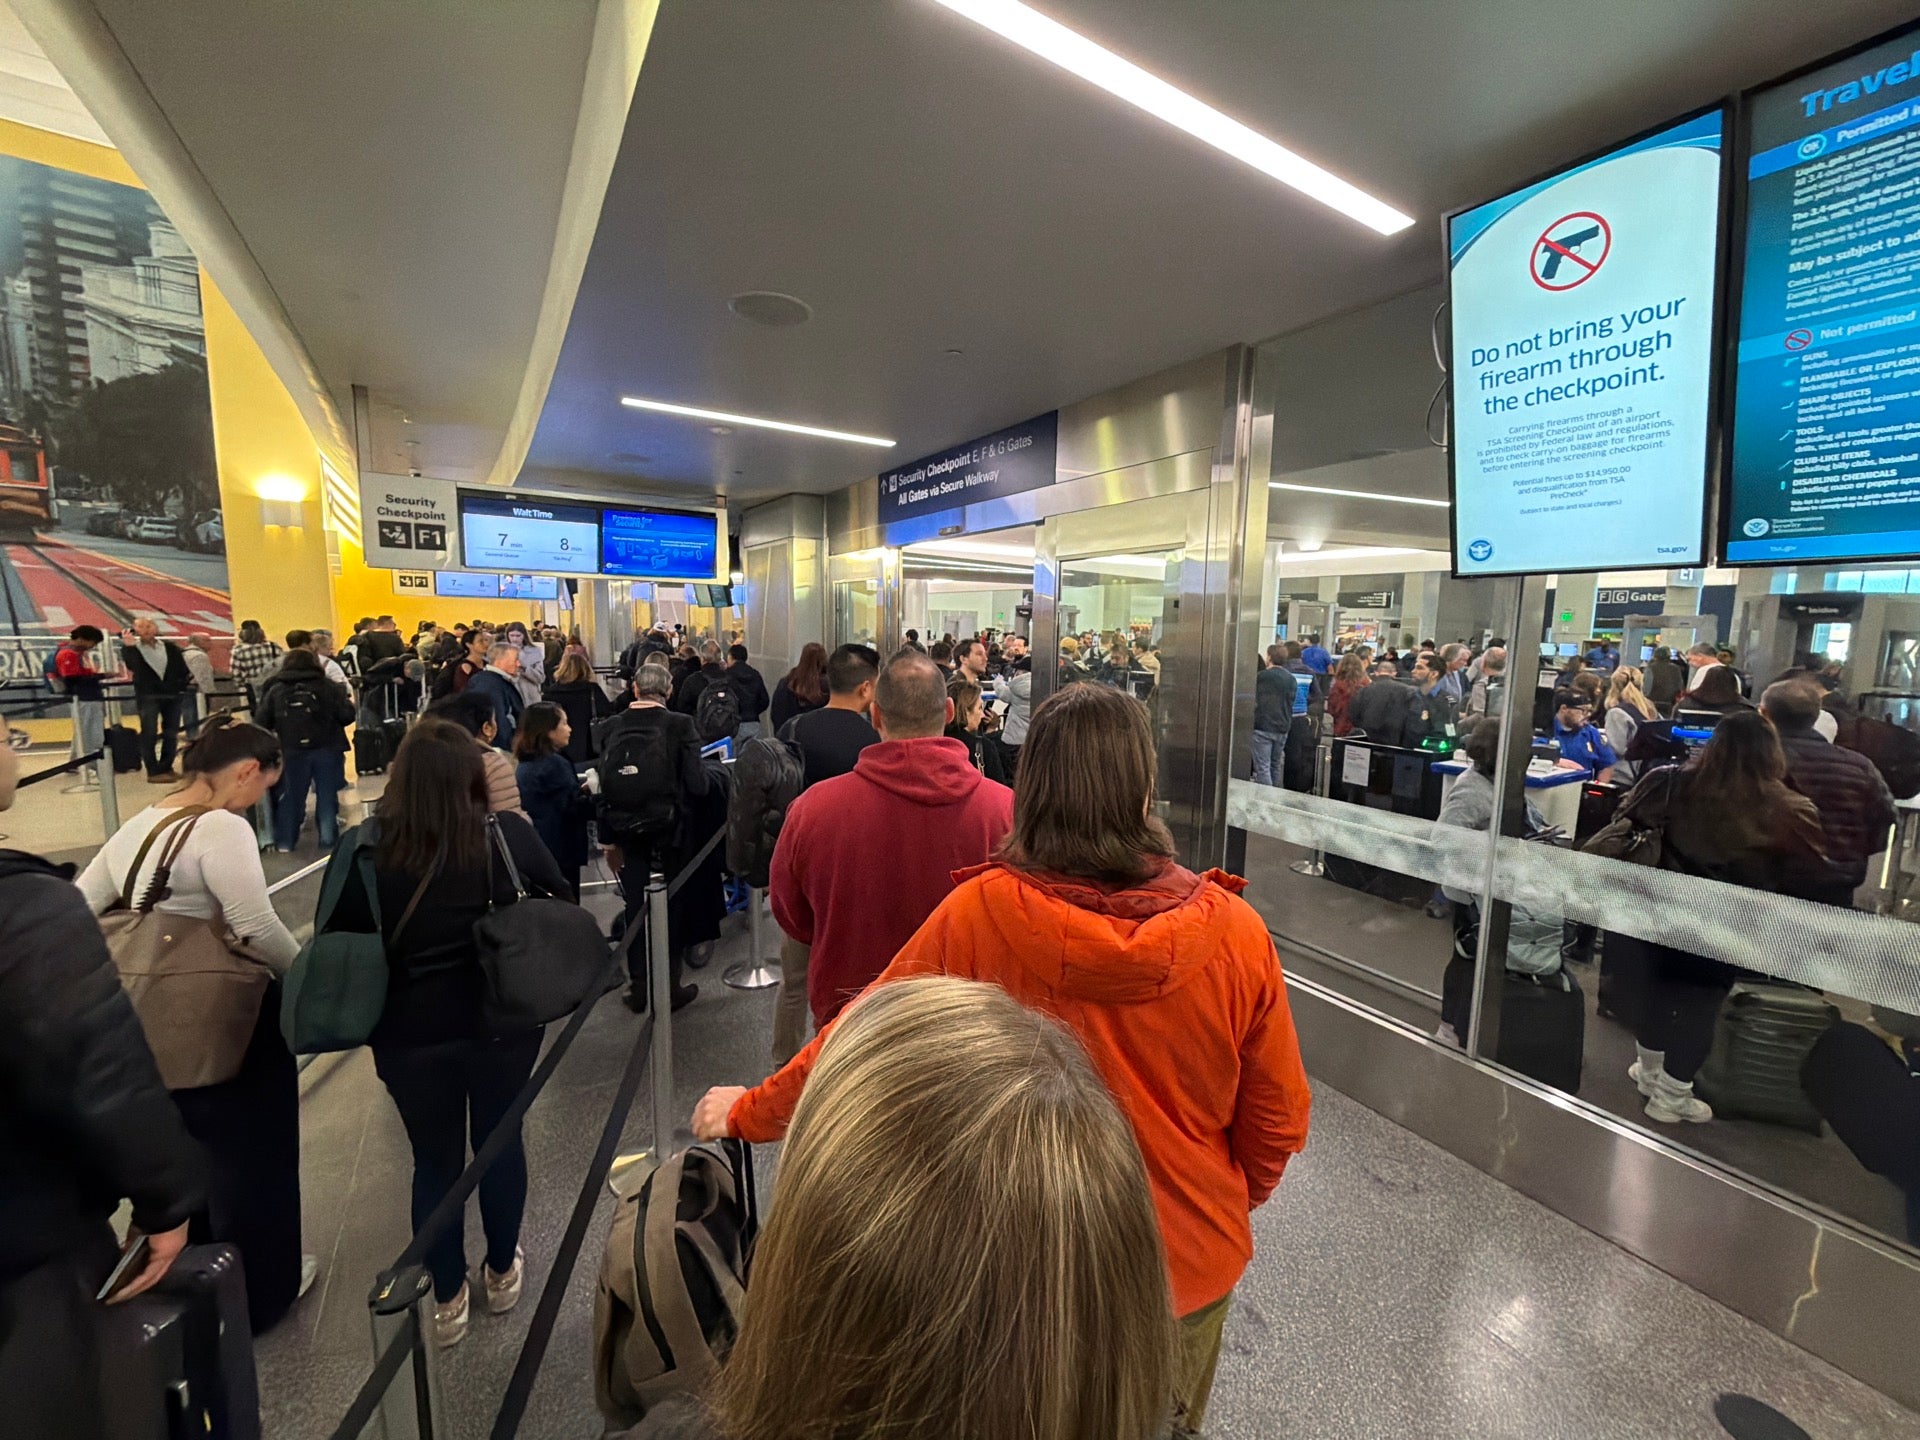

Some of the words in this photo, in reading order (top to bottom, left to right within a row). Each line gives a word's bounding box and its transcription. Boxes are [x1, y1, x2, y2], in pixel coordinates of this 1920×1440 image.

[1800, 50, 1920, 117] Travel
[1837, 107, 1909, 142] Permitted
[1789, 260, 1814, 273] May
[1816, 255, 1833, 265] be
[1835, 240, 1883, 261] subject
[1886, 237, 1900, 248] to
[1472, 348, 1499, 367] Do
[1506, 333, 1542, 358] not
[1549, 317, 1614, 348] bring
[1621, 297, 1686, 333] your
[1820, 327, 1843, 339] Not
[1847, 310, 1916, 336] permitted
[1480, 359, 1562, 390] firearm
[1569, 330, 1672, 369] through
[1802, 351, 1828, 362] GUNS
[1801, 368, 1857, 384] FLAMMABLE
[1858, 365, 1873, 374] OR
[1484, 395, 1518, 414] the
[1524, 362, 1665, 406] checkpoint.
[1798, 395, 1829, 406] SHARP
[1831, 388, 1871, 400] OBJECTS
[1504, 432, 1544, 444] Screening
[1546, 422, 1595, 437] Checkpoint
[1625, 410, 1661, 424] airport
[1508, 423, 1545, 435] Carrying
[1547, 415, 1584, 428] firearms
[1586, 407, 1624, 421] through
[1796, 426, 1824, 436] TOOLS
[1486, 441, 1527, 457] prohibited
[1529, 441, 1539, 449] by
[1542, 436, 1574, 447] Federal
[1577, 433, 1593, 442] law
[1595, 429, 1613, 438] and
[1506, 452, 1530, 461] check
[1531, 447, 1568, 459] carry-on
[1570, 440, 1608, 454] baggage
[1611, 437, 1624, 445] for
[1628, 430, 1671, 442] firearms
[898, 468, 925, 486] Security
[927, 454, 970, 476] Checkpoint
[982, 447, 987, 460] F
[989, 444, 995, 457] &
[998, 441, 1004, 454] G
[1007, 436, 1033, 452] Gates
[1483, 464, 1508, 474] before
[1510, 458, 1544, 470] entering
[1563, 449, 1607, 462] screening
[1794, 453, 1840, 465] CLUB-LIKE
[1841, 450, 1871, 460] ITEMS
[1513, 477, 1544, 487] Potential
[1532, 480, 1587, 493] disqualification
[1792, 475, 1840, 486] DISABLING
[1842, 469, 1898, 481] CHEMICALS
[898, 493, 908, 506] All
[909, 488, 928, 502] Gates
[930, 484, 939, 496] via
[940, 478, 963, 494] Secure
[965, 469, 999, 487] Walkway
[386, 494, 436, 508] Security
[377, 506, 446, 520] Checkpoint
[513, 507, 532, 517] Wait
[532, 509, 553, 519] Time
[420, 530, 441, 545] F1
[498, 533, 508, 546] 7
[560, 538, 568, 550] 8
[416, 578, 428, 586] F1
[1616, 592, 1625, 600] G
[1630, 592, 1666, 601] Gates
